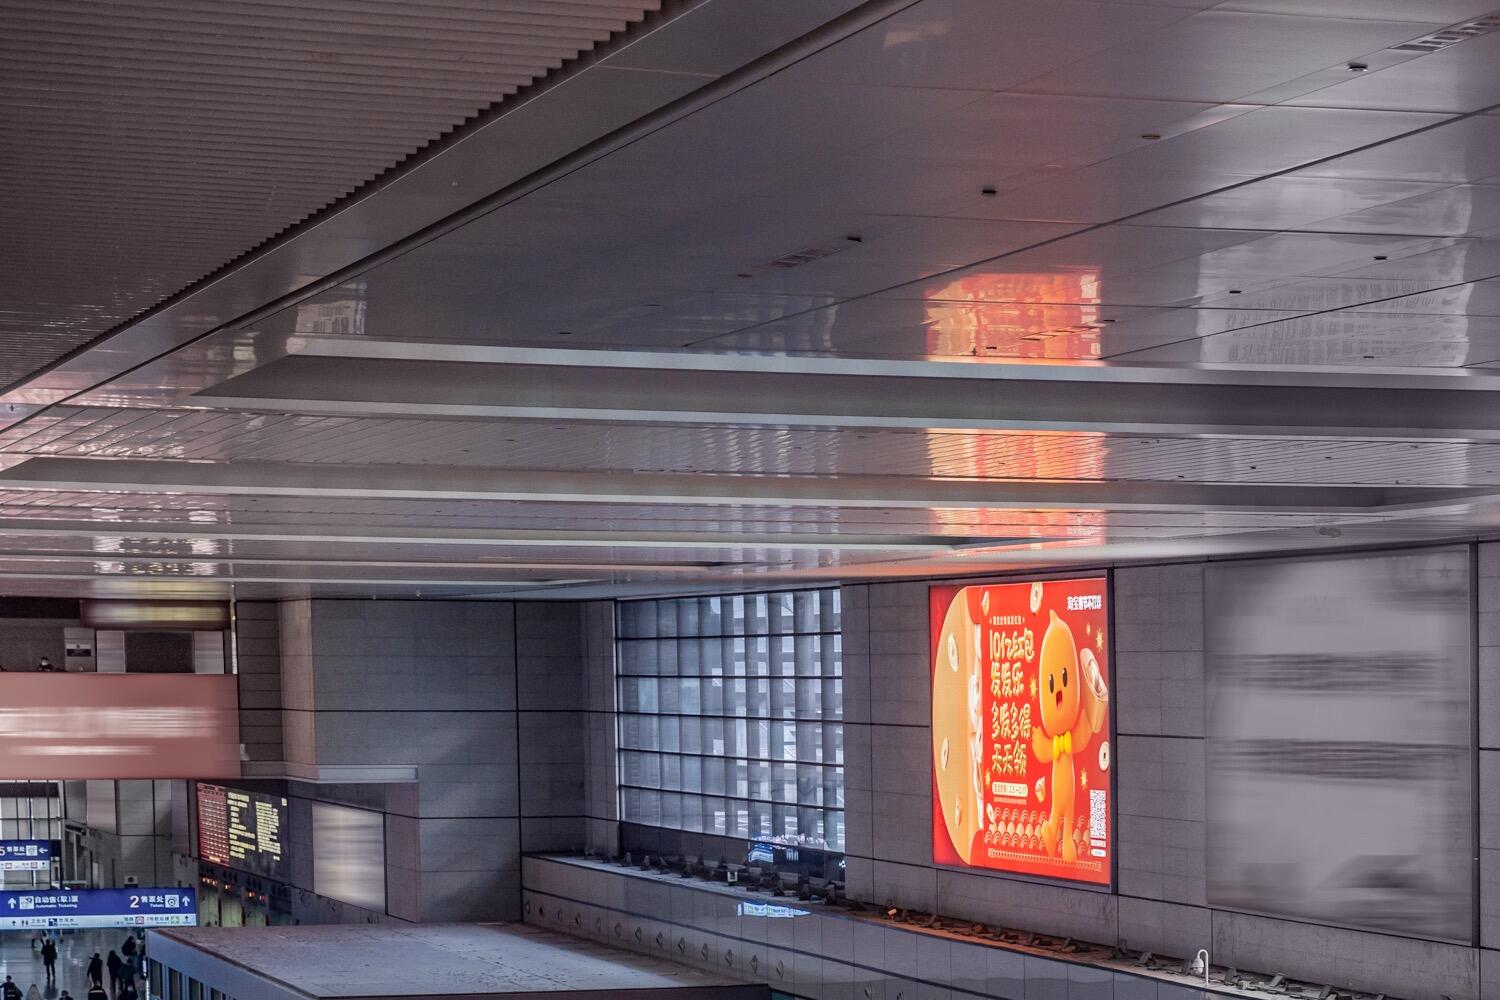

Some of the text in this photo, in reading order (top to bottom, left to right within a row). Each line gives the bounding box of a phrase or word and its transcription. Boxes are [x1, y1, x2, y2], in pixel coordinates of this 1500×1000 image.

[989, 628, 1034, 662] 10亿红包
[130, 896, 139, 908] 2
